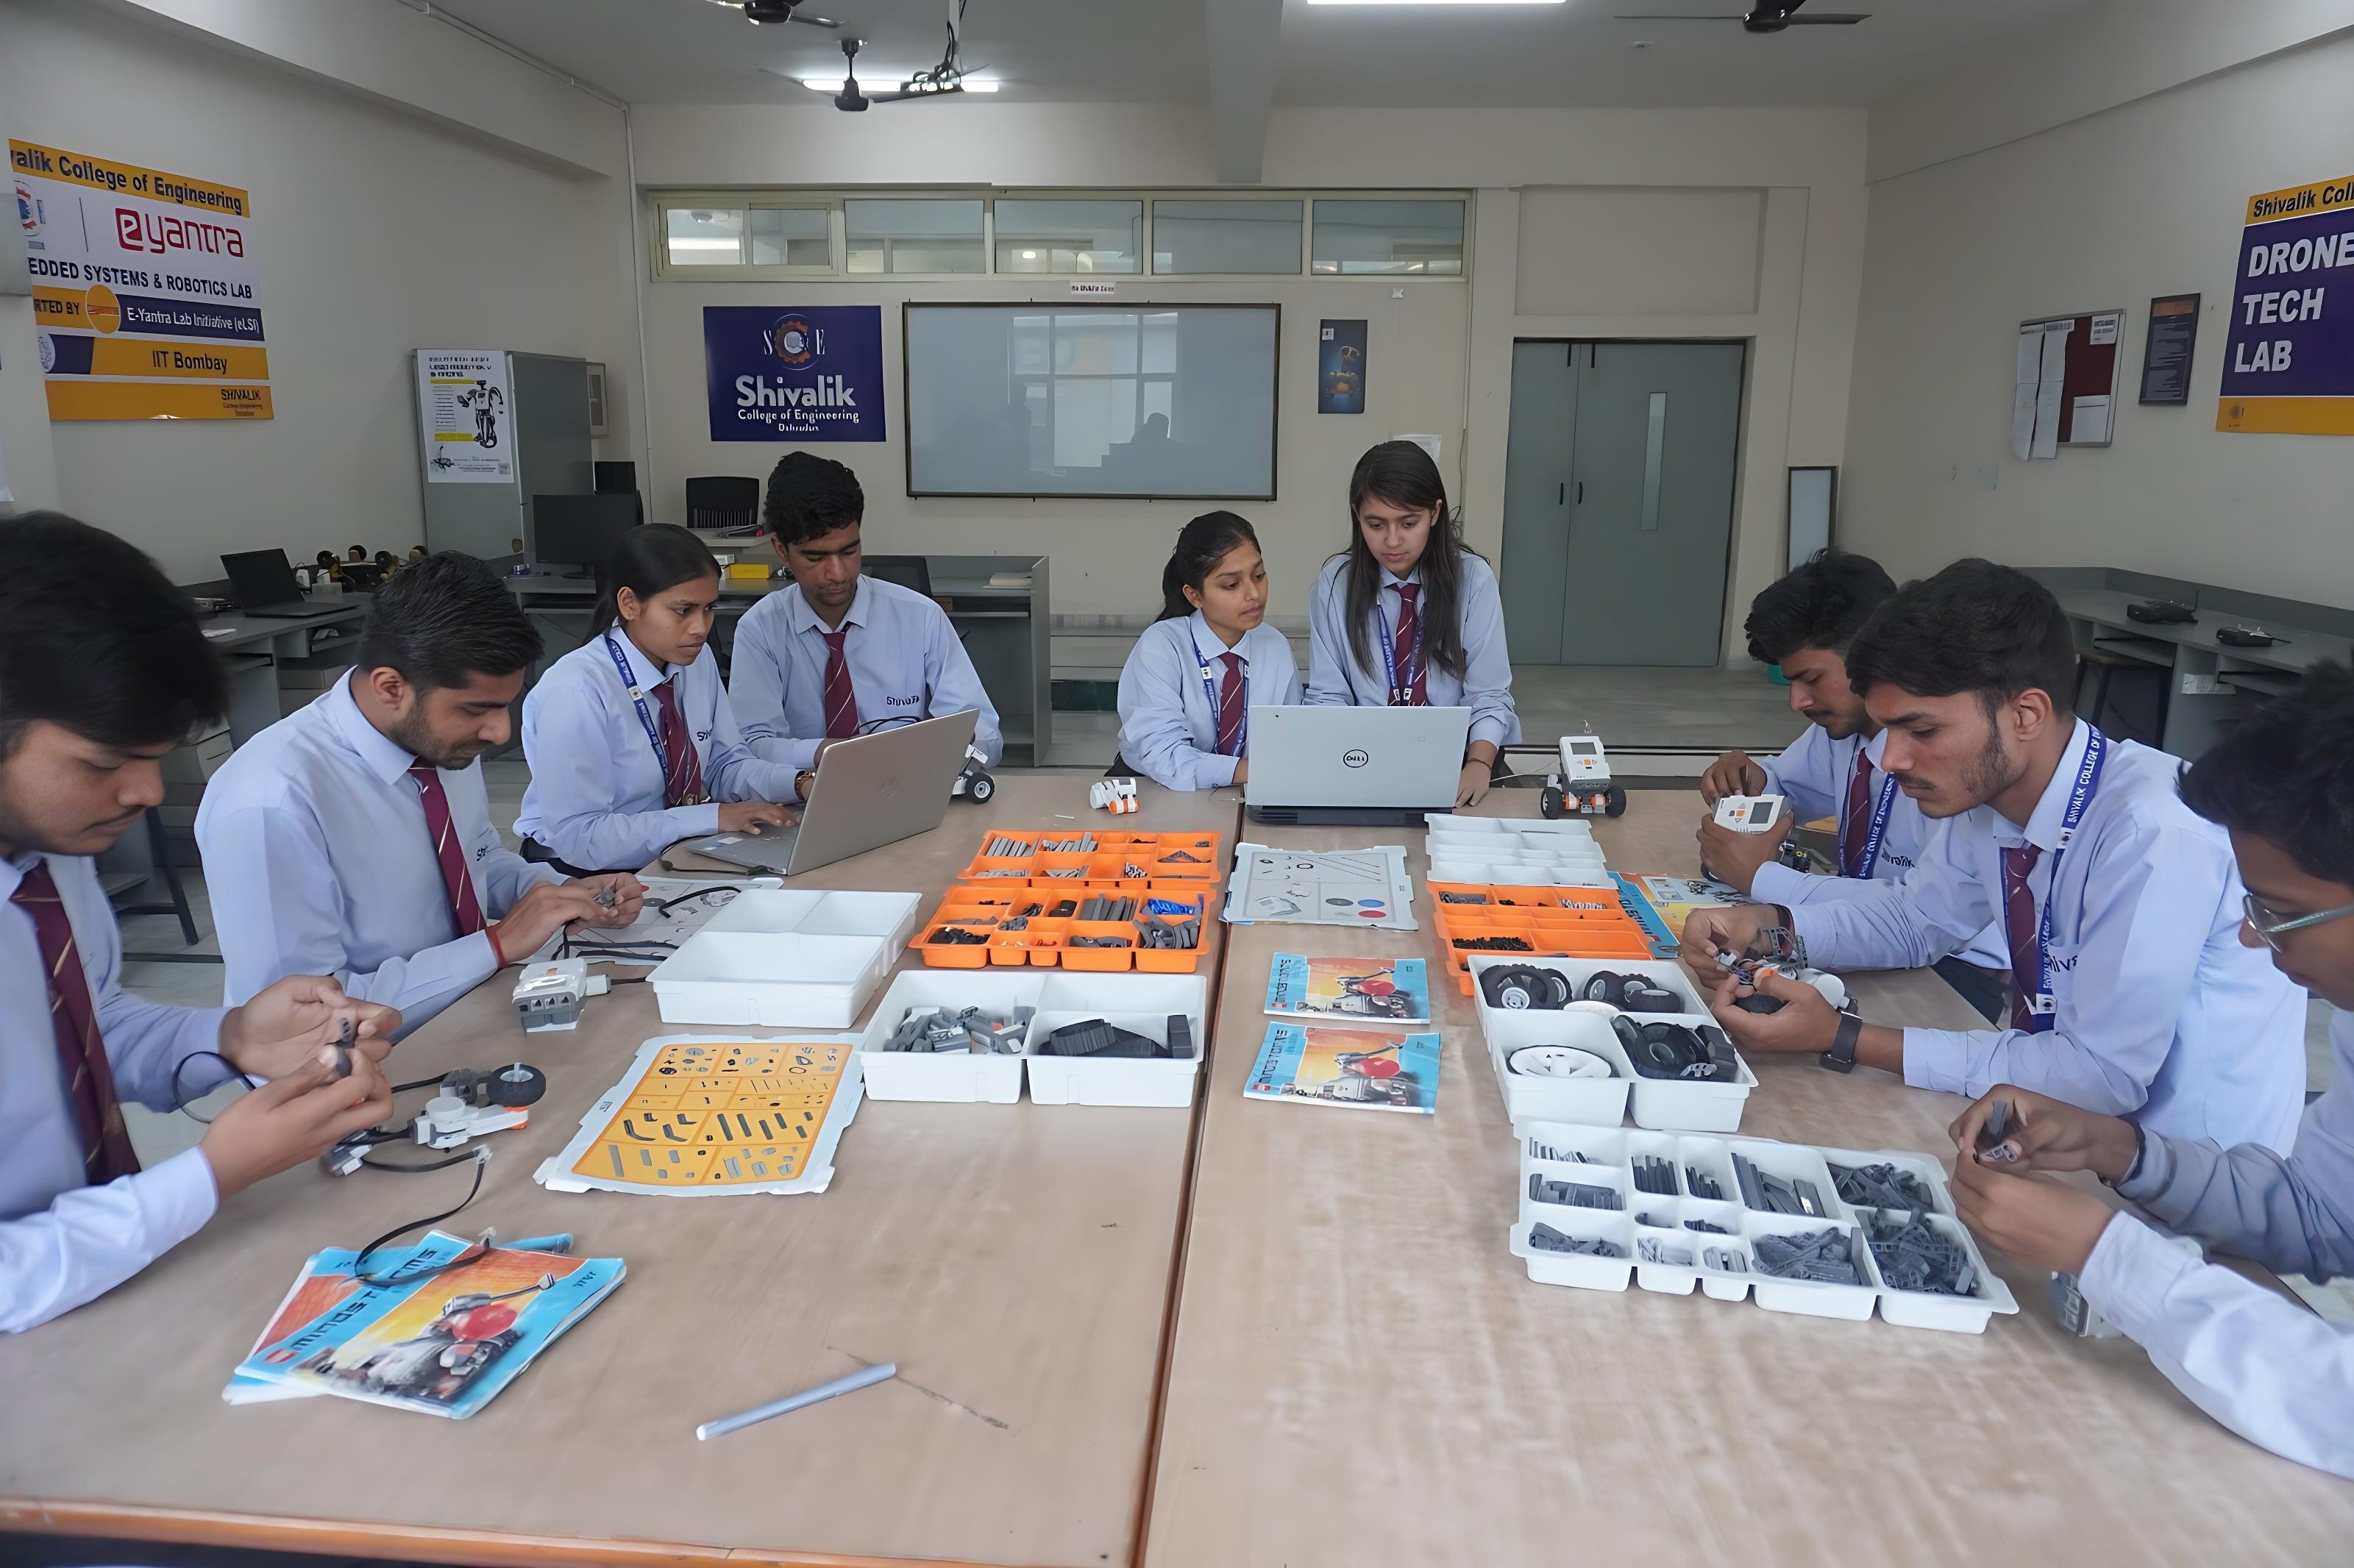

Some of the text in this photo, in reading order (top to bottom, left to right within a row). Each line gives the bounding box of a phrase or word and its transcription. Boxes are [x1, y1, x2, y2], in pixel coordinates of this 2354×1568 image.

[59, 156, 127, 191] College
[132, 174, 148, 192] of
[154, 176, 242, 215] Engineering
[2253, 189, 2316, 218] Shivalik
[2248, 232, 2354, 277] DRONE
[83, 264, 149, 288] SYSTEMS
[154, 273, 163, 288] &
[166, 275, 227, 296] ROBOTICS
[230, 283, 252, 299] LAB
[65, 302, 80, 316] BY
[127, 307, 171, 324] E-Yantra
[173, 311, 192, 325] Lab
[2243, 288, 2325, 325] TECH
[152, 350, 227, 374] IIT Bombay
[2234, 340, 2292, 373] LAB
[736, 374, 856, 407] Shivalik
[738, 409, 859, 424] College of Engineering
